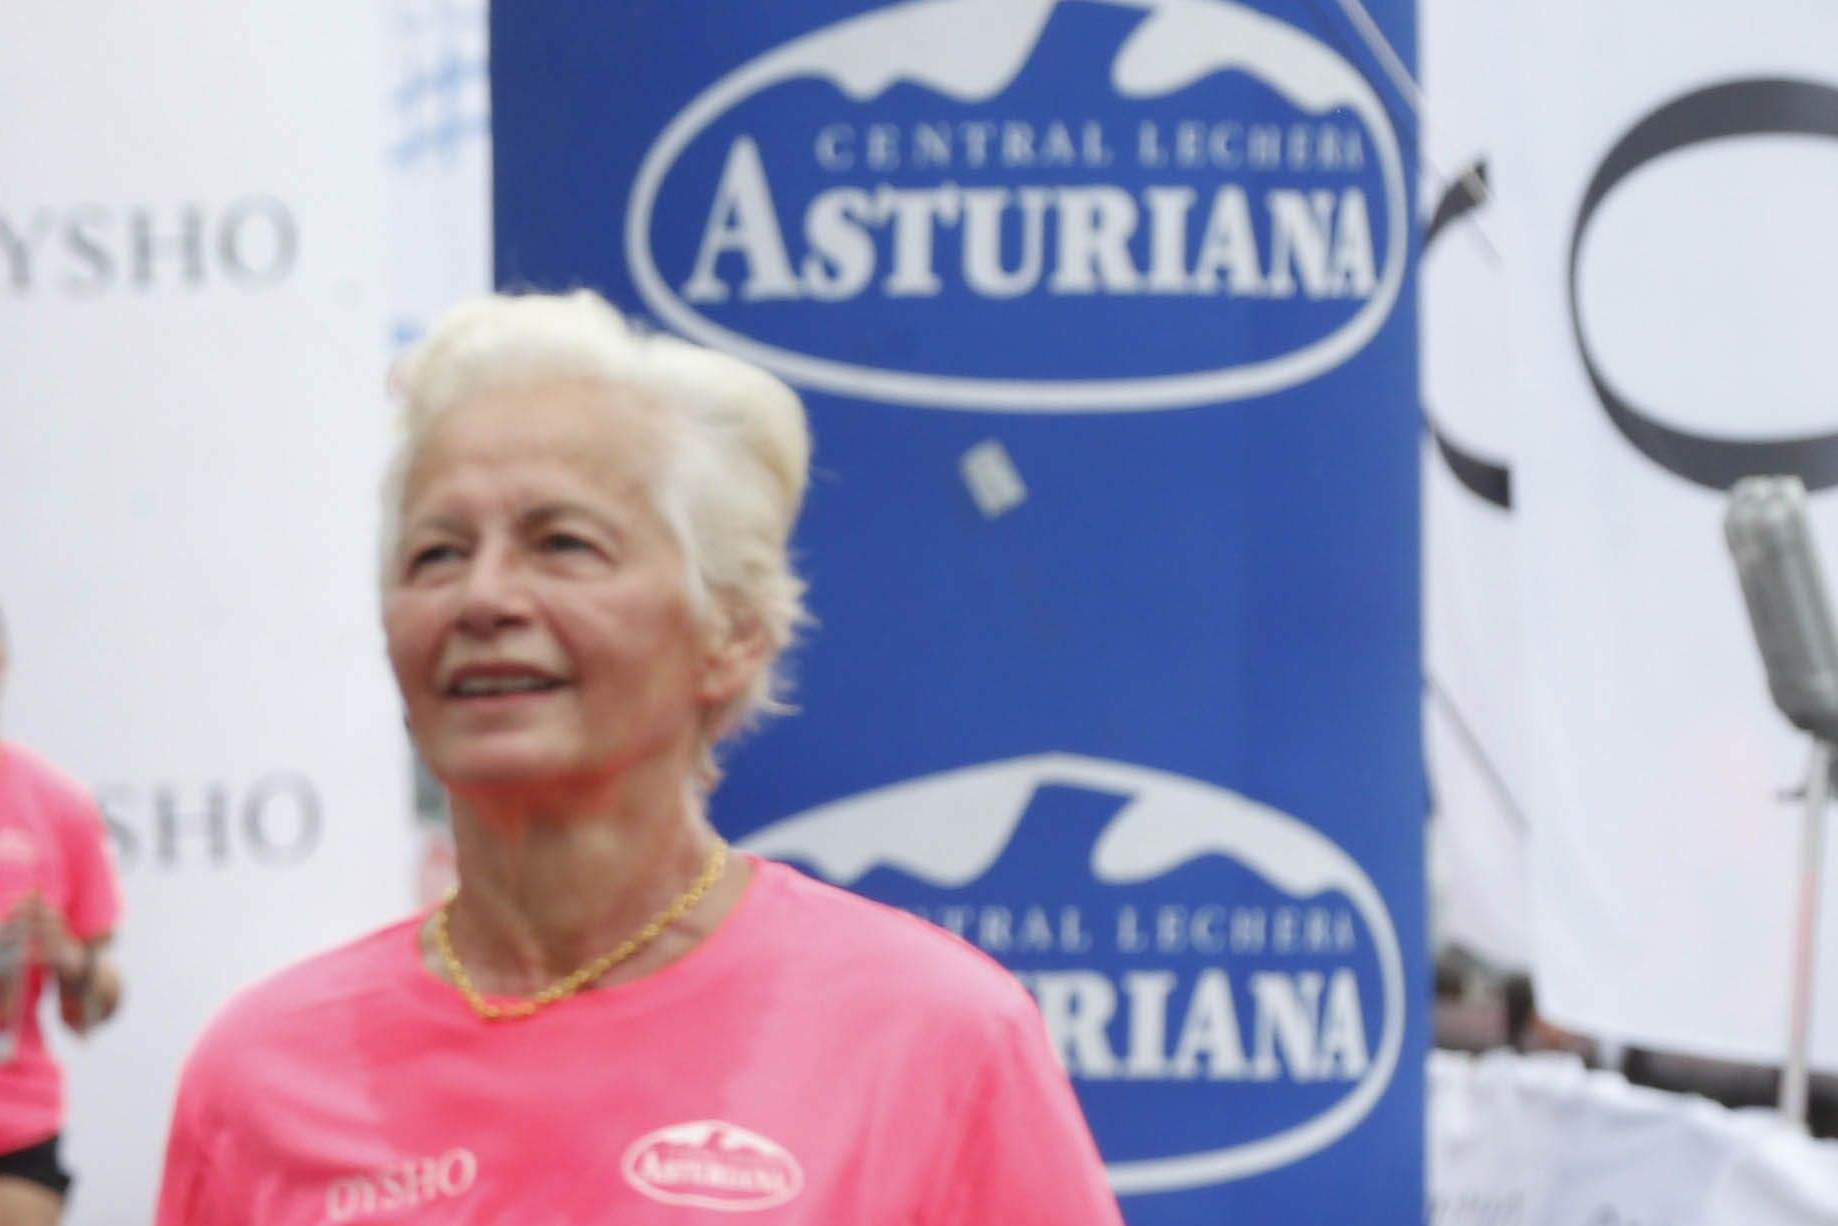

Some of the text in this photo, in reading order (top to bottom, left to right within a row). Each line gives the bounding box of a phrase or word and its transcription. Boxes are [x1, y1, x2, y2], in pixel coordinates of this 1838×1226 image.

[815, 121, 1365, 172] CENTRAL LECHERA
[681, 136, 1379, 300] ASTURIANA
[1116, 904, 1356, 955] LECHERA
[1022, 967, 1370, 1081] RIANA
